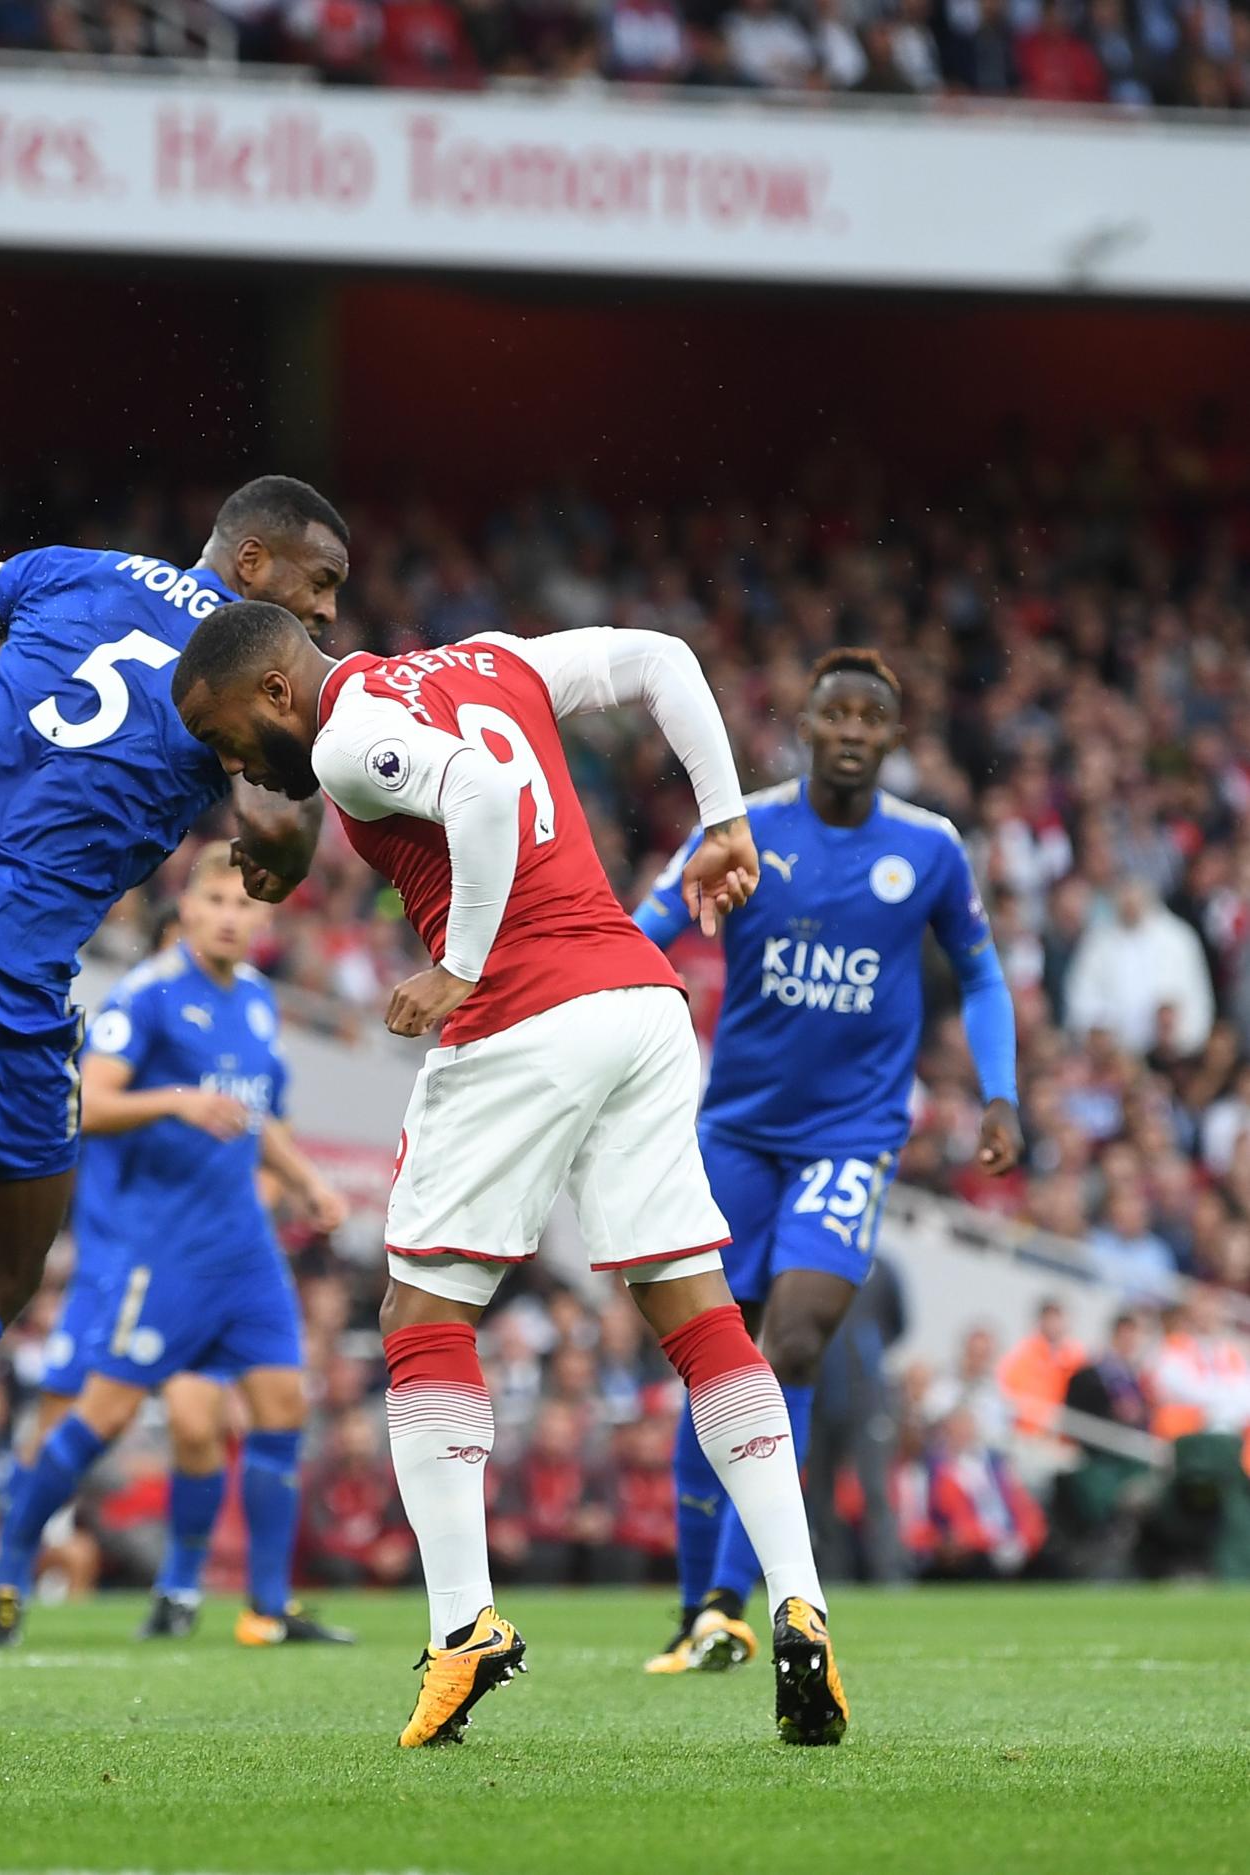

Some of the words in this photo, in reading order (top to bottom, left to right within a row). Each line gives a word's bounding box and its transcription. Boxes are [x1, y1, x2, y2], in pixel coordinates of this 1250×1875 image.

[154, 102, 376, 208] Hello
[28, 628, 182, 749] 5
[455, 702, 556, 845] 9
[760, 971, 875, 1014] POWER
[762, 936, 881, 985] KING
[793, 1157, 874, 1218] 25
